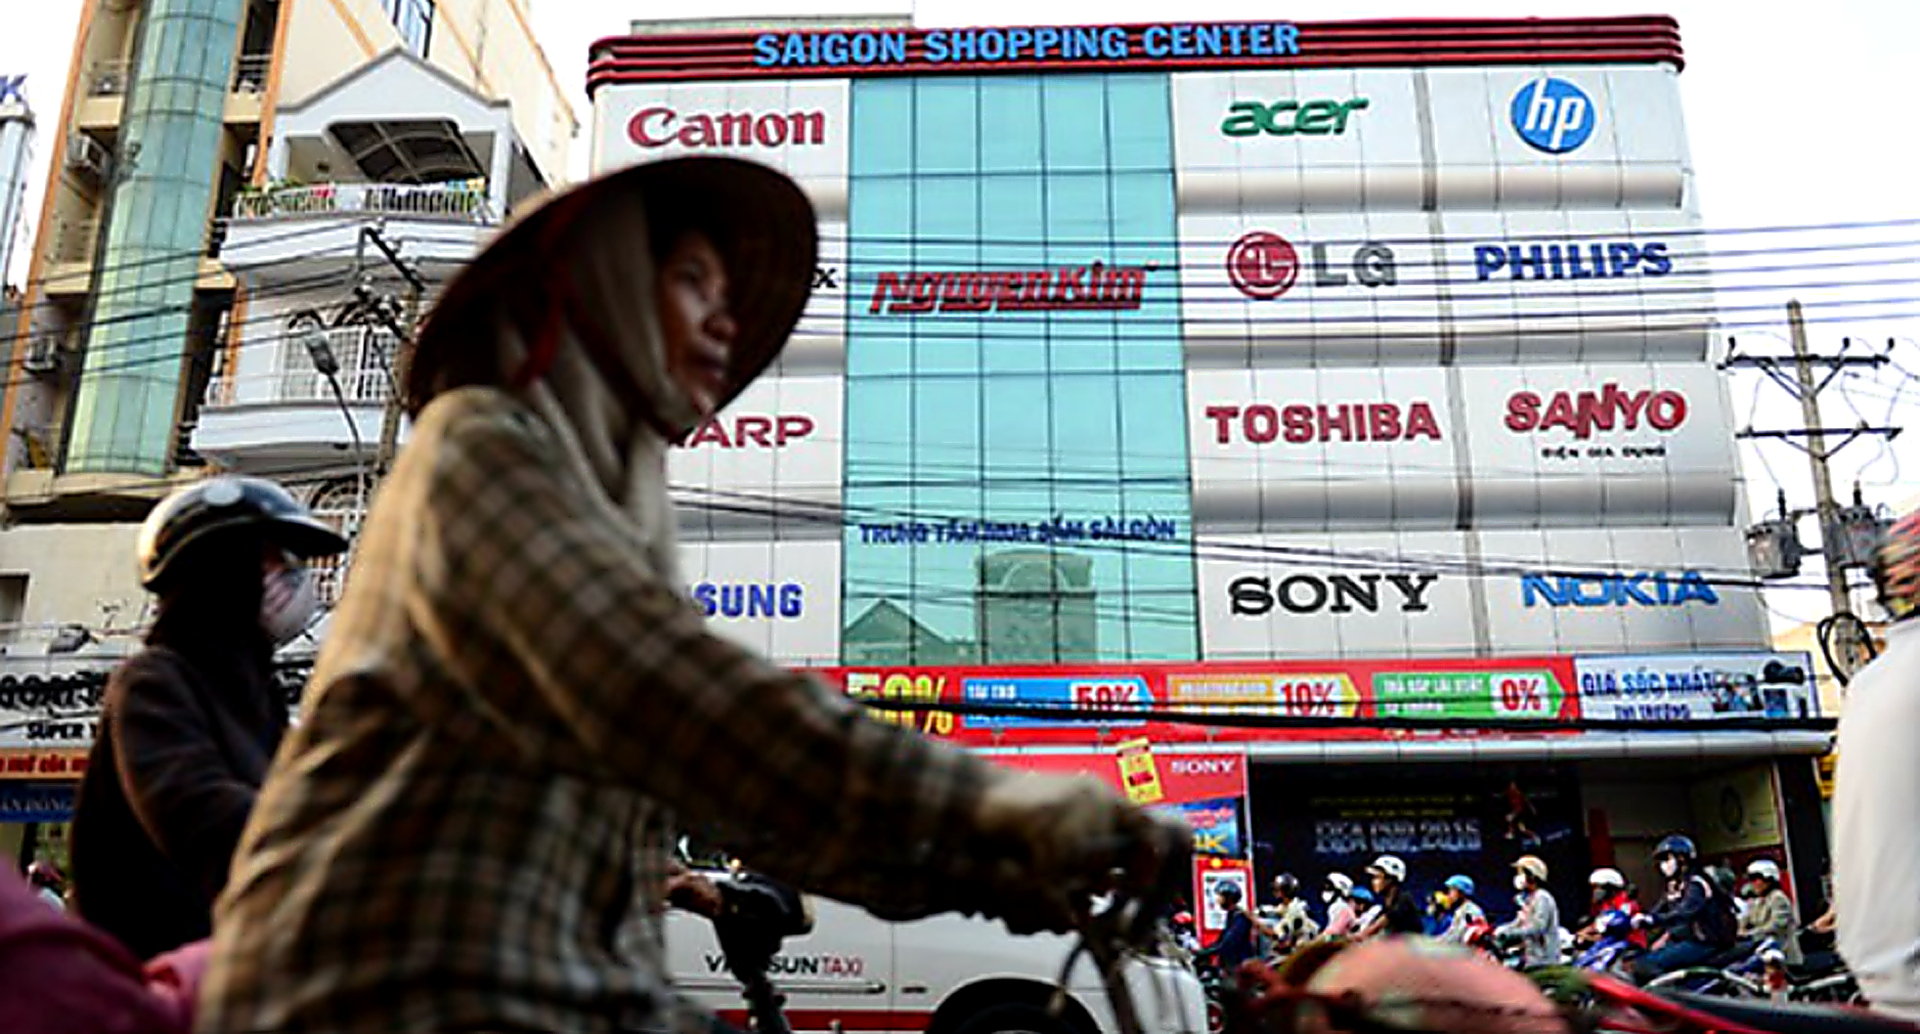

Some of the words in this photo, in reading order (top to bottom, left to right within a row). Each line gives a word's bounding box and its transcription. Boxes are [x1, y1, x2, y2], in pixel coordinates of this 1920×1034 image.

[753, 32, 907, 66] SAIGON
[921, 26, 1129, 63] SHOPPING
[1142, 22, 1300, 57] CENTER
[626, 106, 826, 148] Canon
[1221, 99, 1371, 136] acer
[1524, 77, 1586, 150] hp
[1311, 242, 1397, 287] LG
[1473, 241, 1673, 281] PHILIPS
[1205, 402, 1442, 444] TOSHIBA
[1503, 383, 1688, 440] SANYO
[1228, 574, 1438, 615] SONY
[1521, 570, 1721, 606] NOKIA
[1279, 681, 1337, 717] 10%
[1501, 678, 1542, 712] 0%
[1170, 759, 1237, 775] SONY
